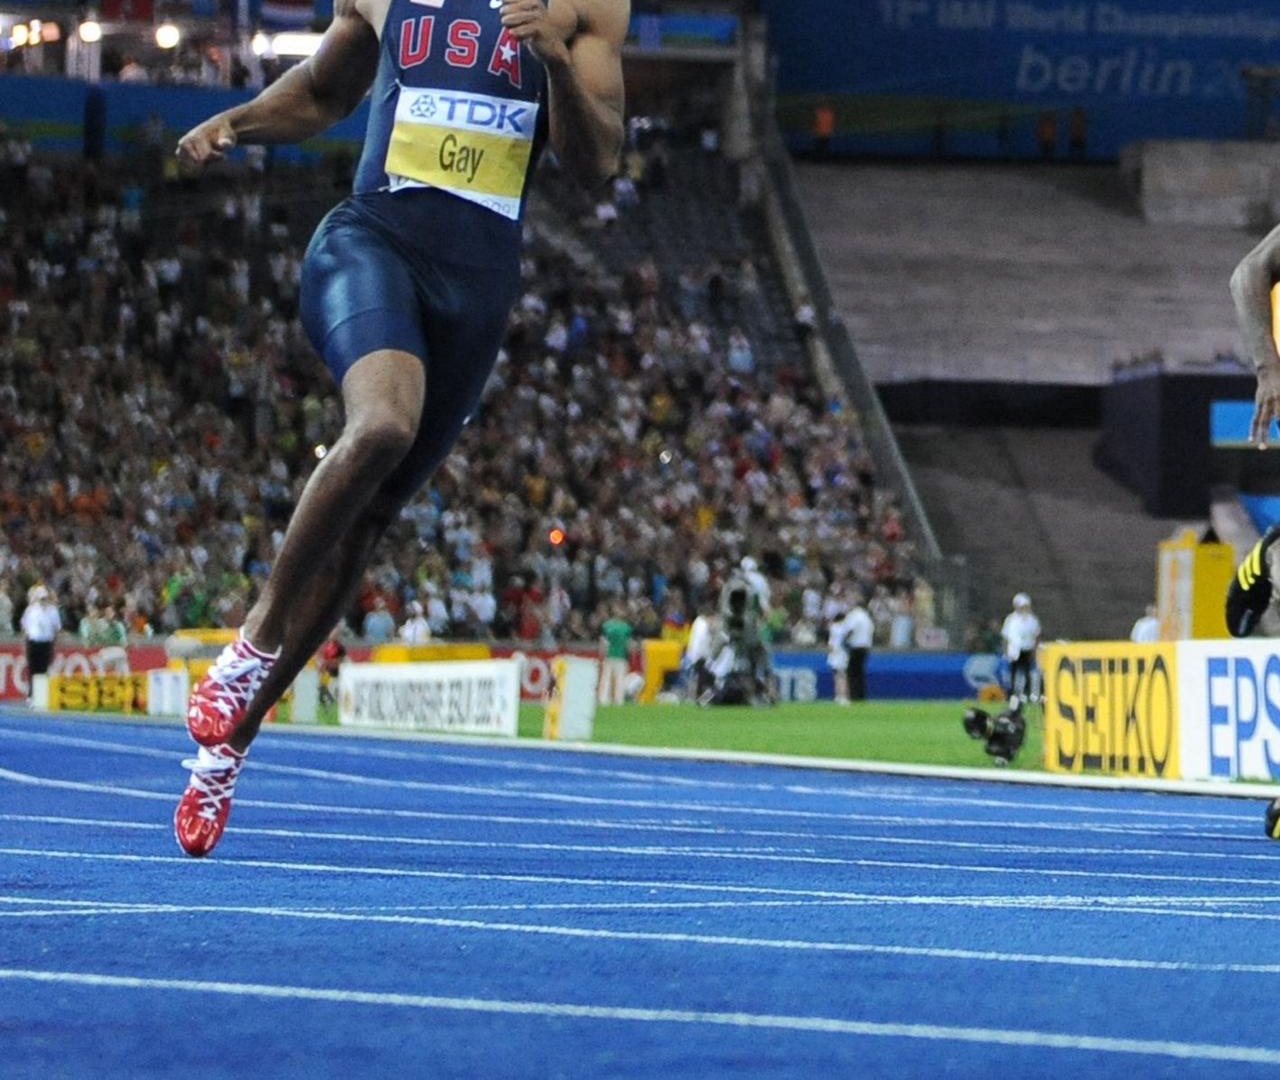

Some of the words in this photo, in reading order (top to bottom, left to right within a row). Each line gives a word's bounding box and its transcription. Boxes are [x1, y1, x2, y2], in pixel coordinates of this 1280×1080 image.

[399, 15, 522, 89] USA
[1015, 43, 1193, 95] berlin
[439, 96, 527, 133] TDK
[438, 133, 484, 184] Gay
[1054, 653, 1172, 777] SEIKO
